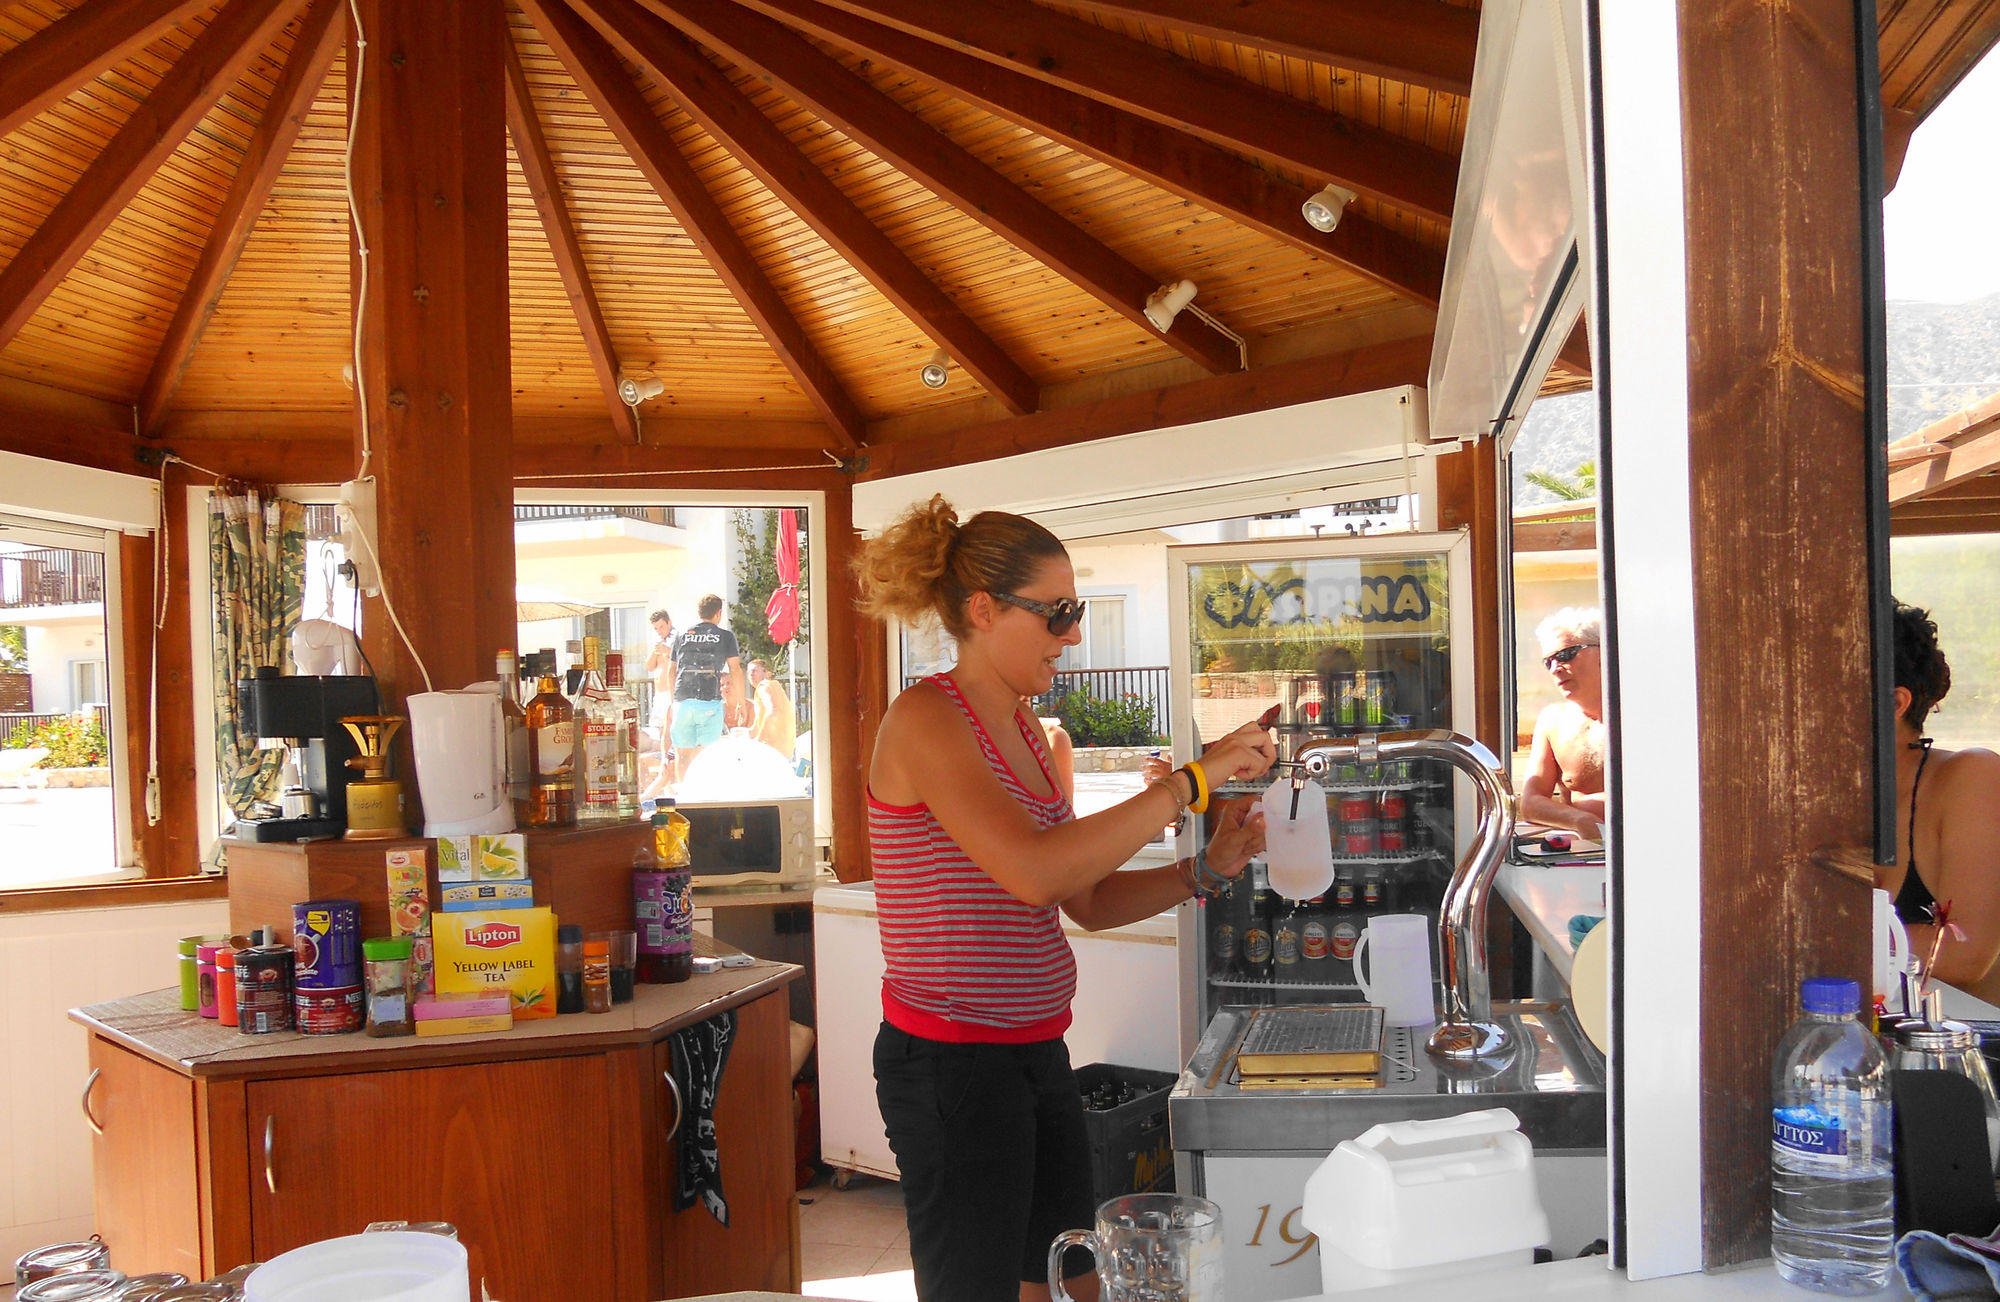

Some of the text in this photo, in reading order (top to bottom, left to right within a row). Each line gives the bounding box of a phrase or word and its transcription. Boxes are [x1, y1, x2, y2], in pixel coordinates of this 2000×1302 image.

[441, 848, 470, 862] Vital
[468, 929, 518, 945] Lipton
[453, 959, 535, 973] YELLOW LABEL
[484, 973, 506, 983] TEA
